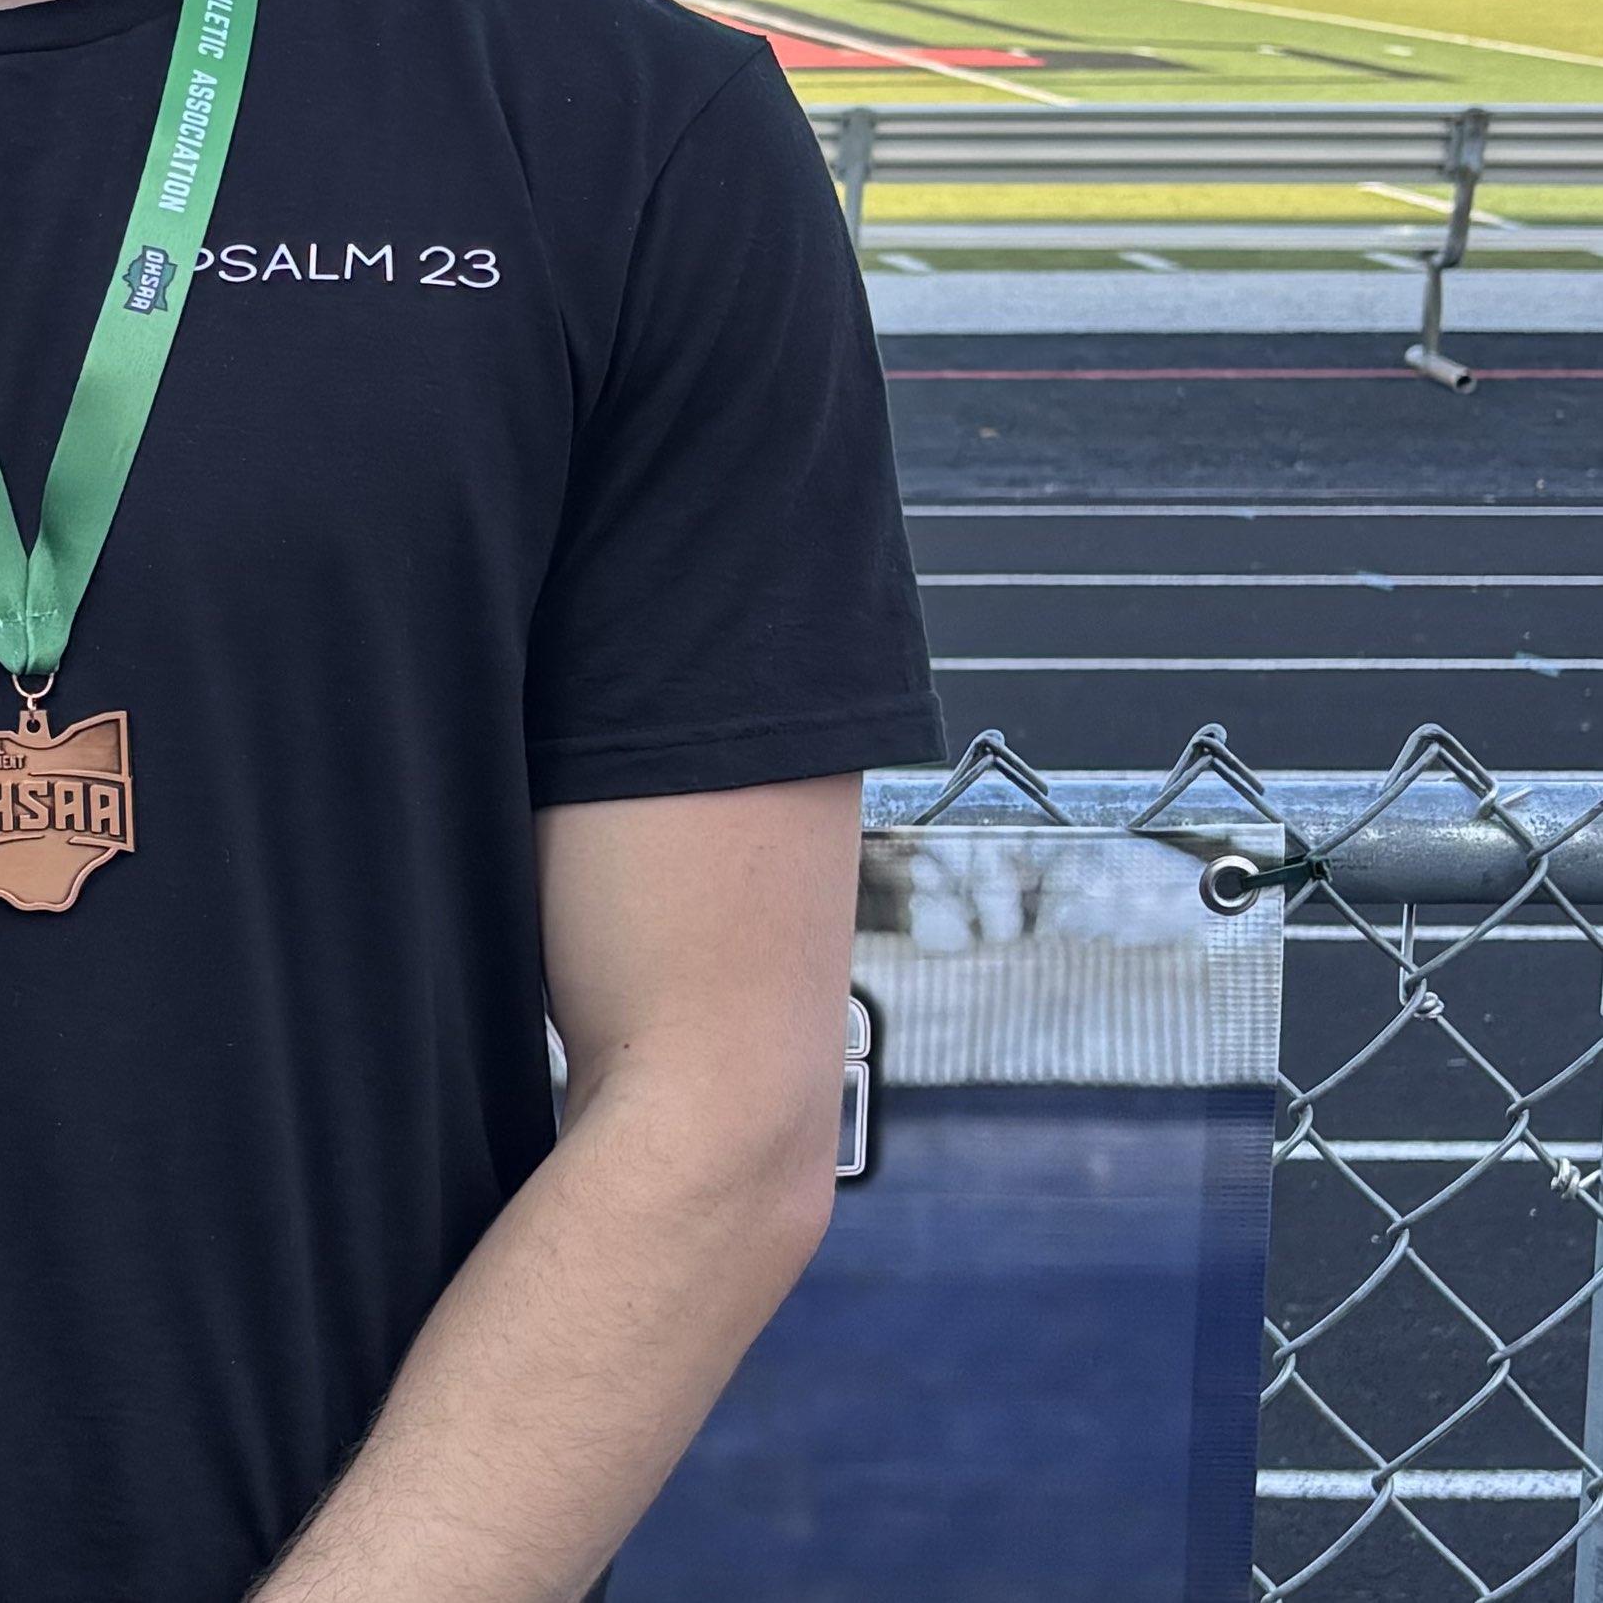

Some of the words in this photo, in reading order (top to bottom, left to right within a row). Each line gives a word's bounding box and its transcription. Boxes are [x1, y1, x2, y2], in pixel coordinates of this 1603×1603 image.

[158, 69, 218, 214] ASSOCIATION
[130, 249, 165, 311] OHSAA
[419, 245, 500, 289] 23
